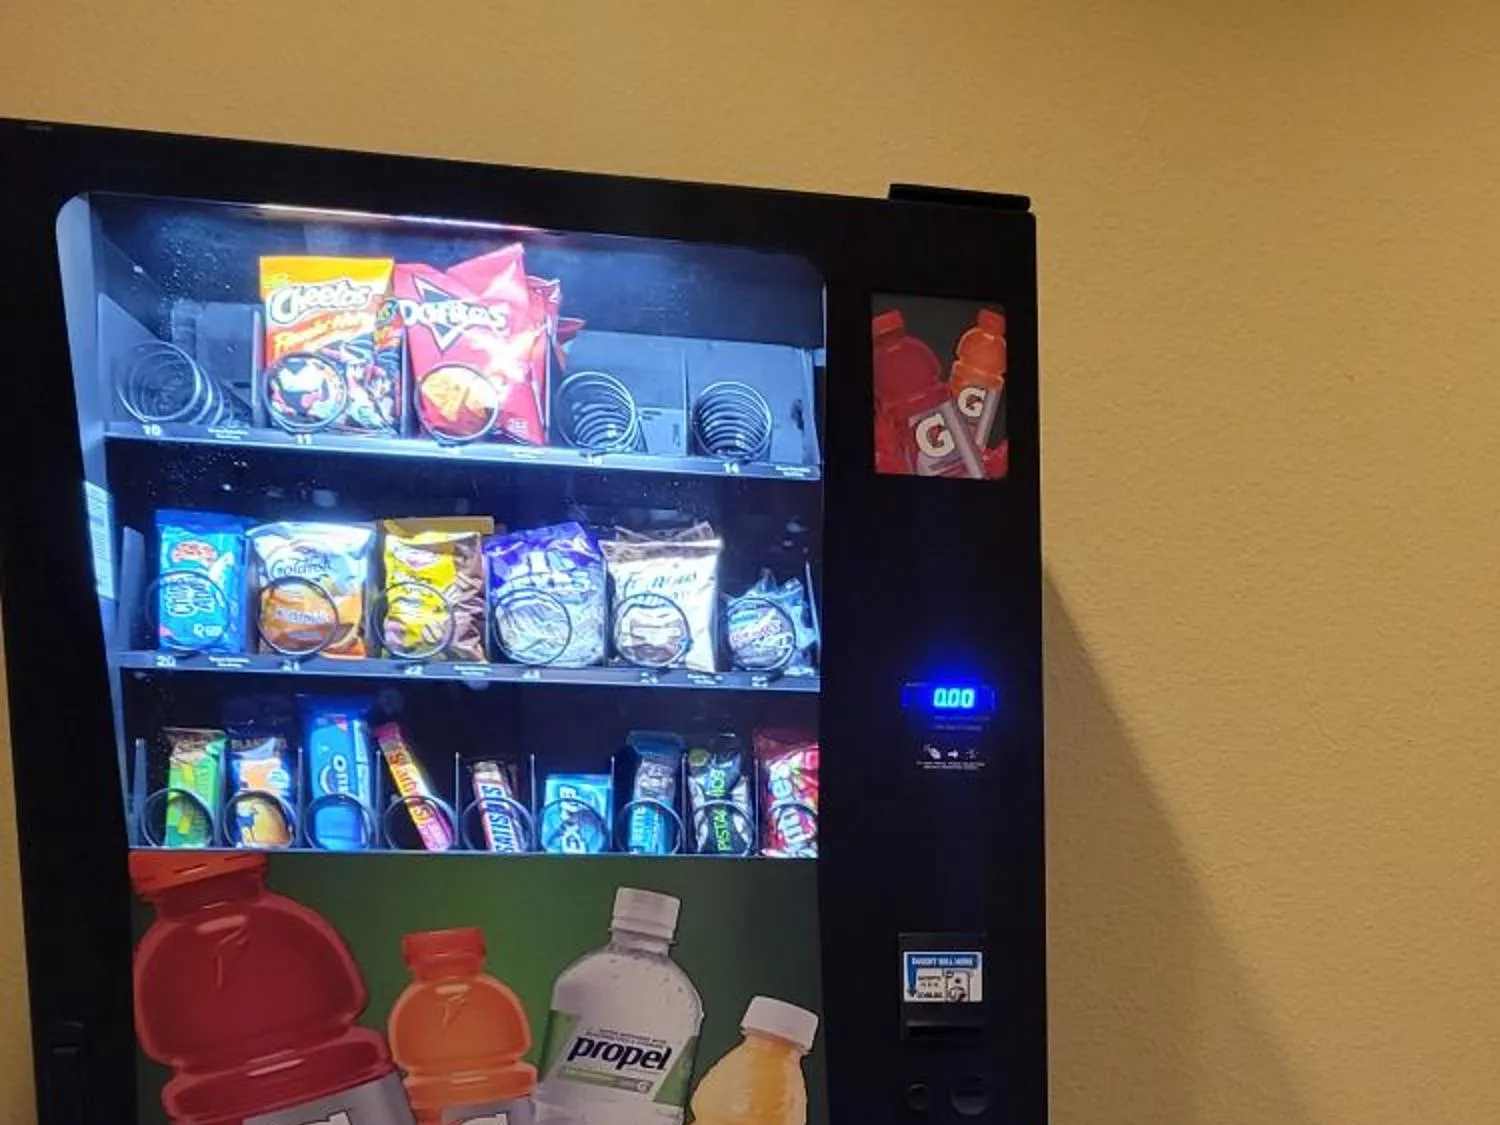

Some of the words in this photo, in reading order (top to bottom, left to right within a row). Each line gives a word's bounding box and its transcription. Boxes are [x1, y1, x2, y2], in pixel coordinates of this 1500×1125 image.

[957, 387, 987, 417] G
[915, 413, 956, 457] G
[566, 1036, 673, 1070] propel
